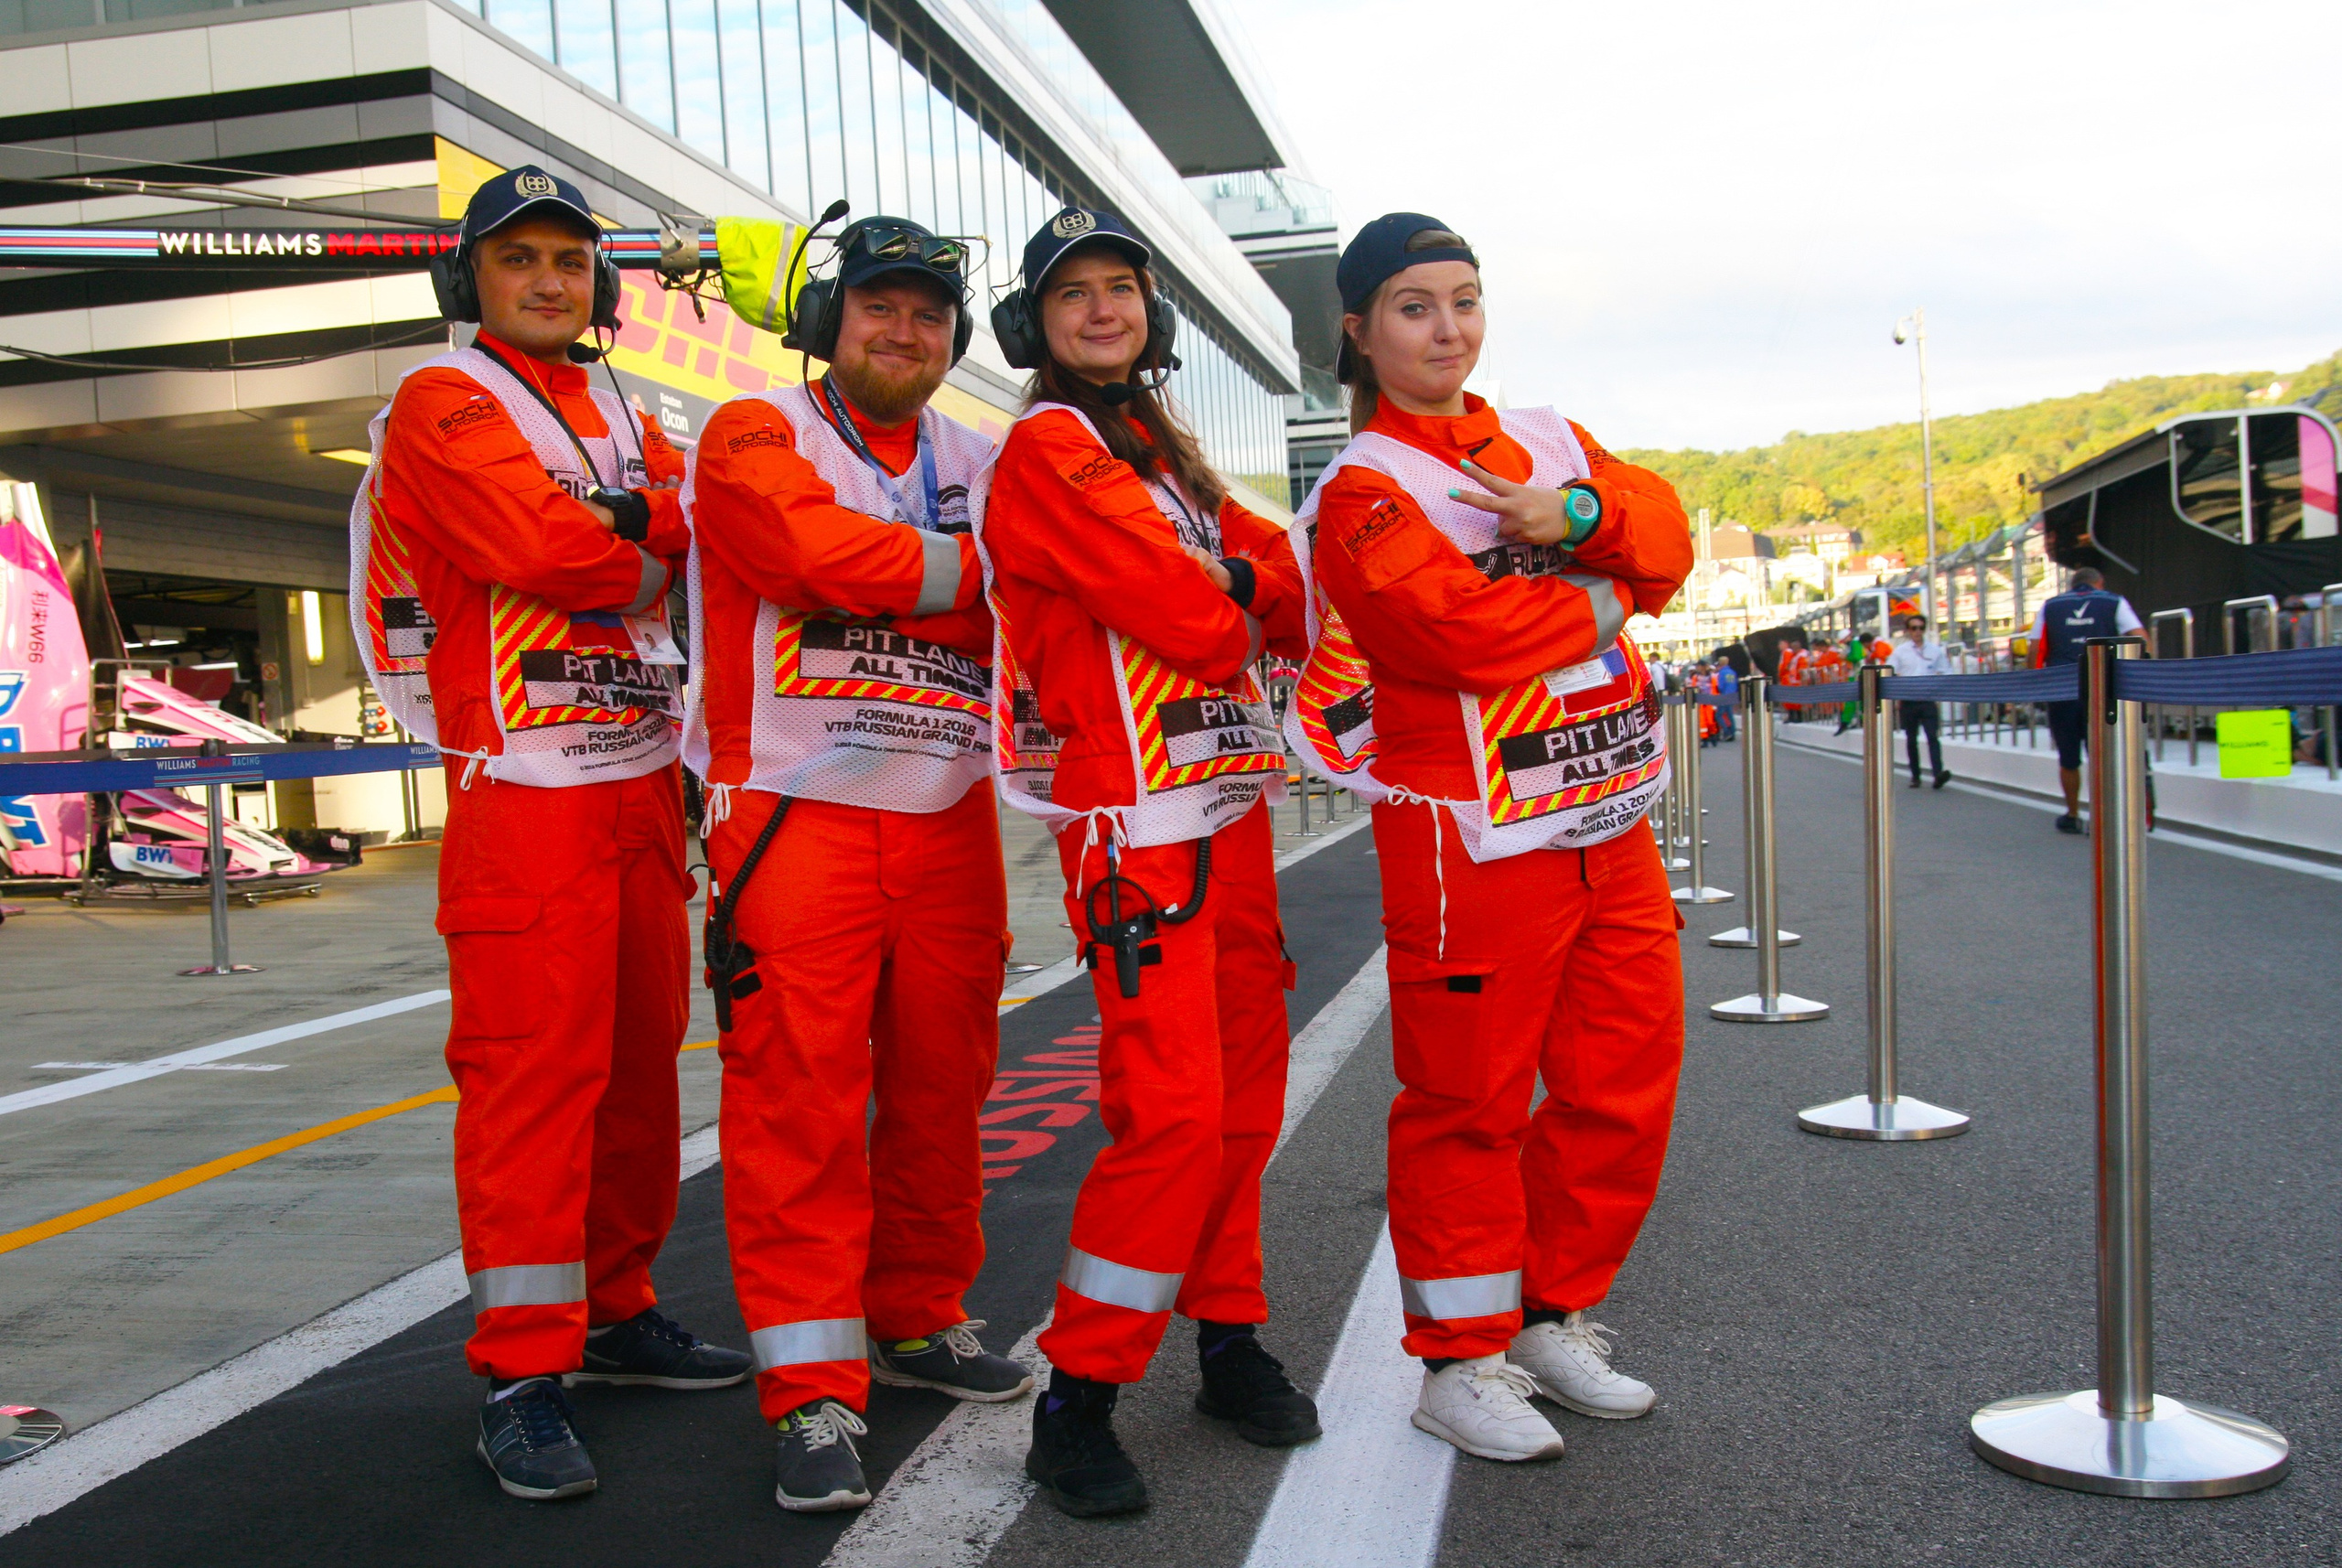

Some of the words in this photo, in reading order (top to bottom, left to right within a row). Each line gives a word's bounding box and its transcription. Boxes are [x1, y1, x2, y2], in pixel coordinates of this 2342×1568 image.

[159, 232, 322, 255] WILLIAMS
[660, 392, 682, 409] Esteban
[437, 401, 497, 431] SOCHI
[443, 411, 500, 436] AUTODROM
[661, 407, 689, 433] Ocon
[836, 407, 864, 446] AUTODROM
[727, 431, 787, 447] SOCHI
[729, 440, 789, 455] AUTODROM
[1346, 502, 1400, 551] SOCHI
[1352, 511, 1405, 553] AUTODROM
[843, 628, 899, 652] PIT
[908, 639, 985, 686] LANE
[849, 655, 902, 679] ALL
[908, 663, 986, 698] TIMES
[855, 709, 929, 728] FORMULA
[931, 718, 939, 729] 1
[940, 719, 976, 737] 2018
[1199, 699, 1238, 725] PIT
[562, 744, 586, 757] VTB
[588, 733, 645, 754] RUSSIAN
[824, 721, 852, 733] VTB
[853, 721, 919, 739] RUSSIAN
[921, 730, 972, 747] GRAND
[1217, 731, 1253, 752] ALL
[1544, 724, 1597, 759] PIT
[1603, 706, 1649, 746] LANE
[156, 758, 197, 770] WILLIAMS
[232, 757, 261, 767] RACING
[1562, 757, 1609, 784] ALL
[1610, 737, 1655, 771] TIMES
